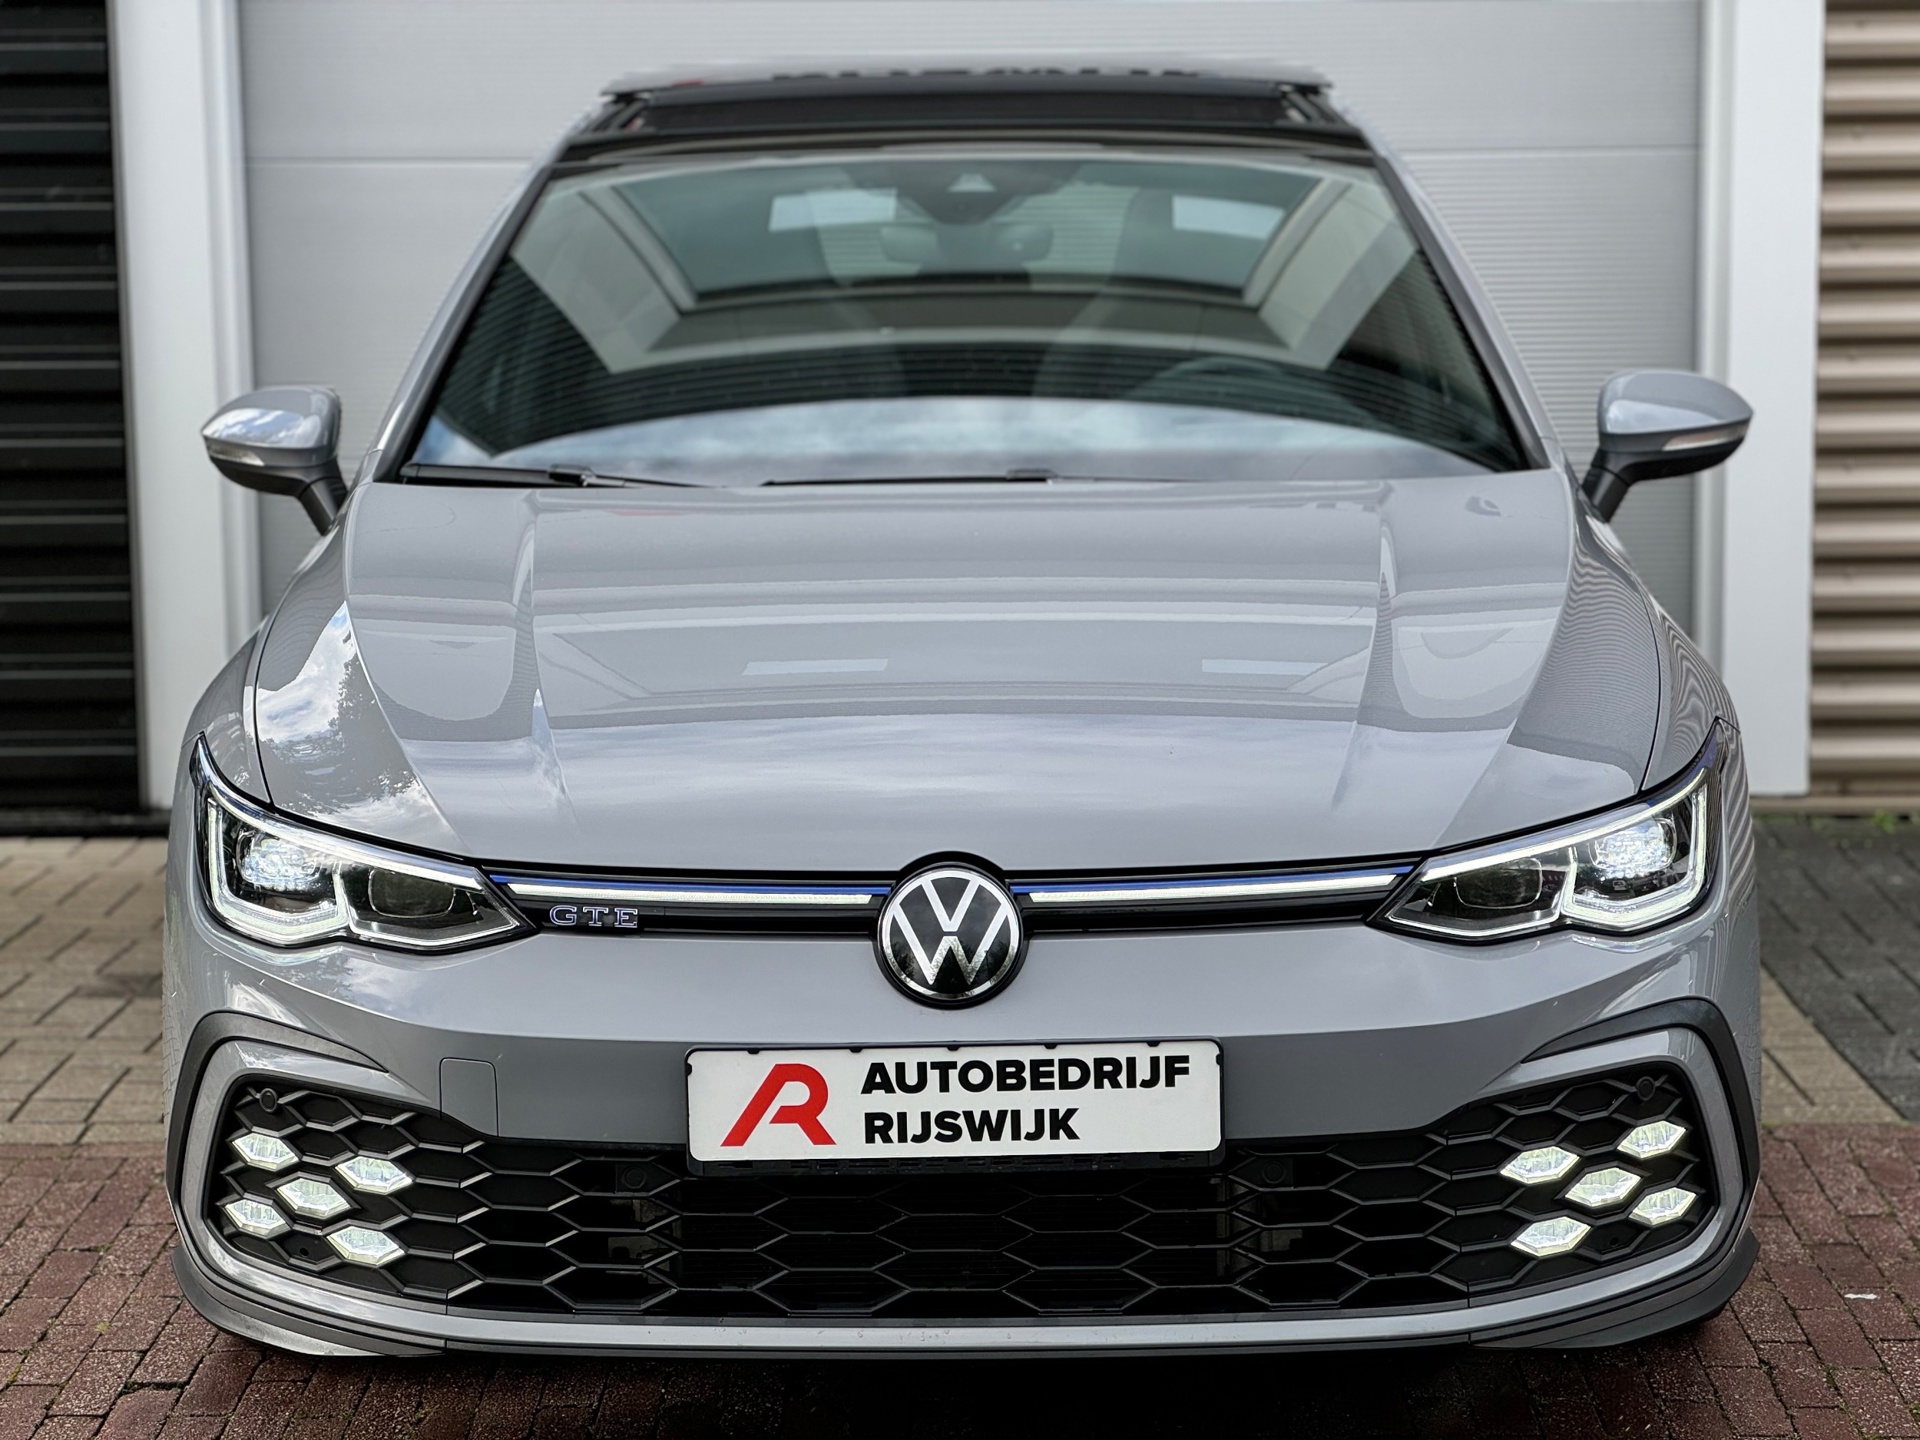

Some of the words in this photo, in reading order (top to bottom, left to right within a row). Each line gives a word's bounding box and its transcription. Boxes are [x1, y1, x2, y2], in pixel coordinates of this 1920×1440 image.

[549, 904, 639, 929] GTE
[860, 1055, 1190, 1095] AUTOBEDRIJF
[864, 1107, 1081, 1145] RIJSWIJK
